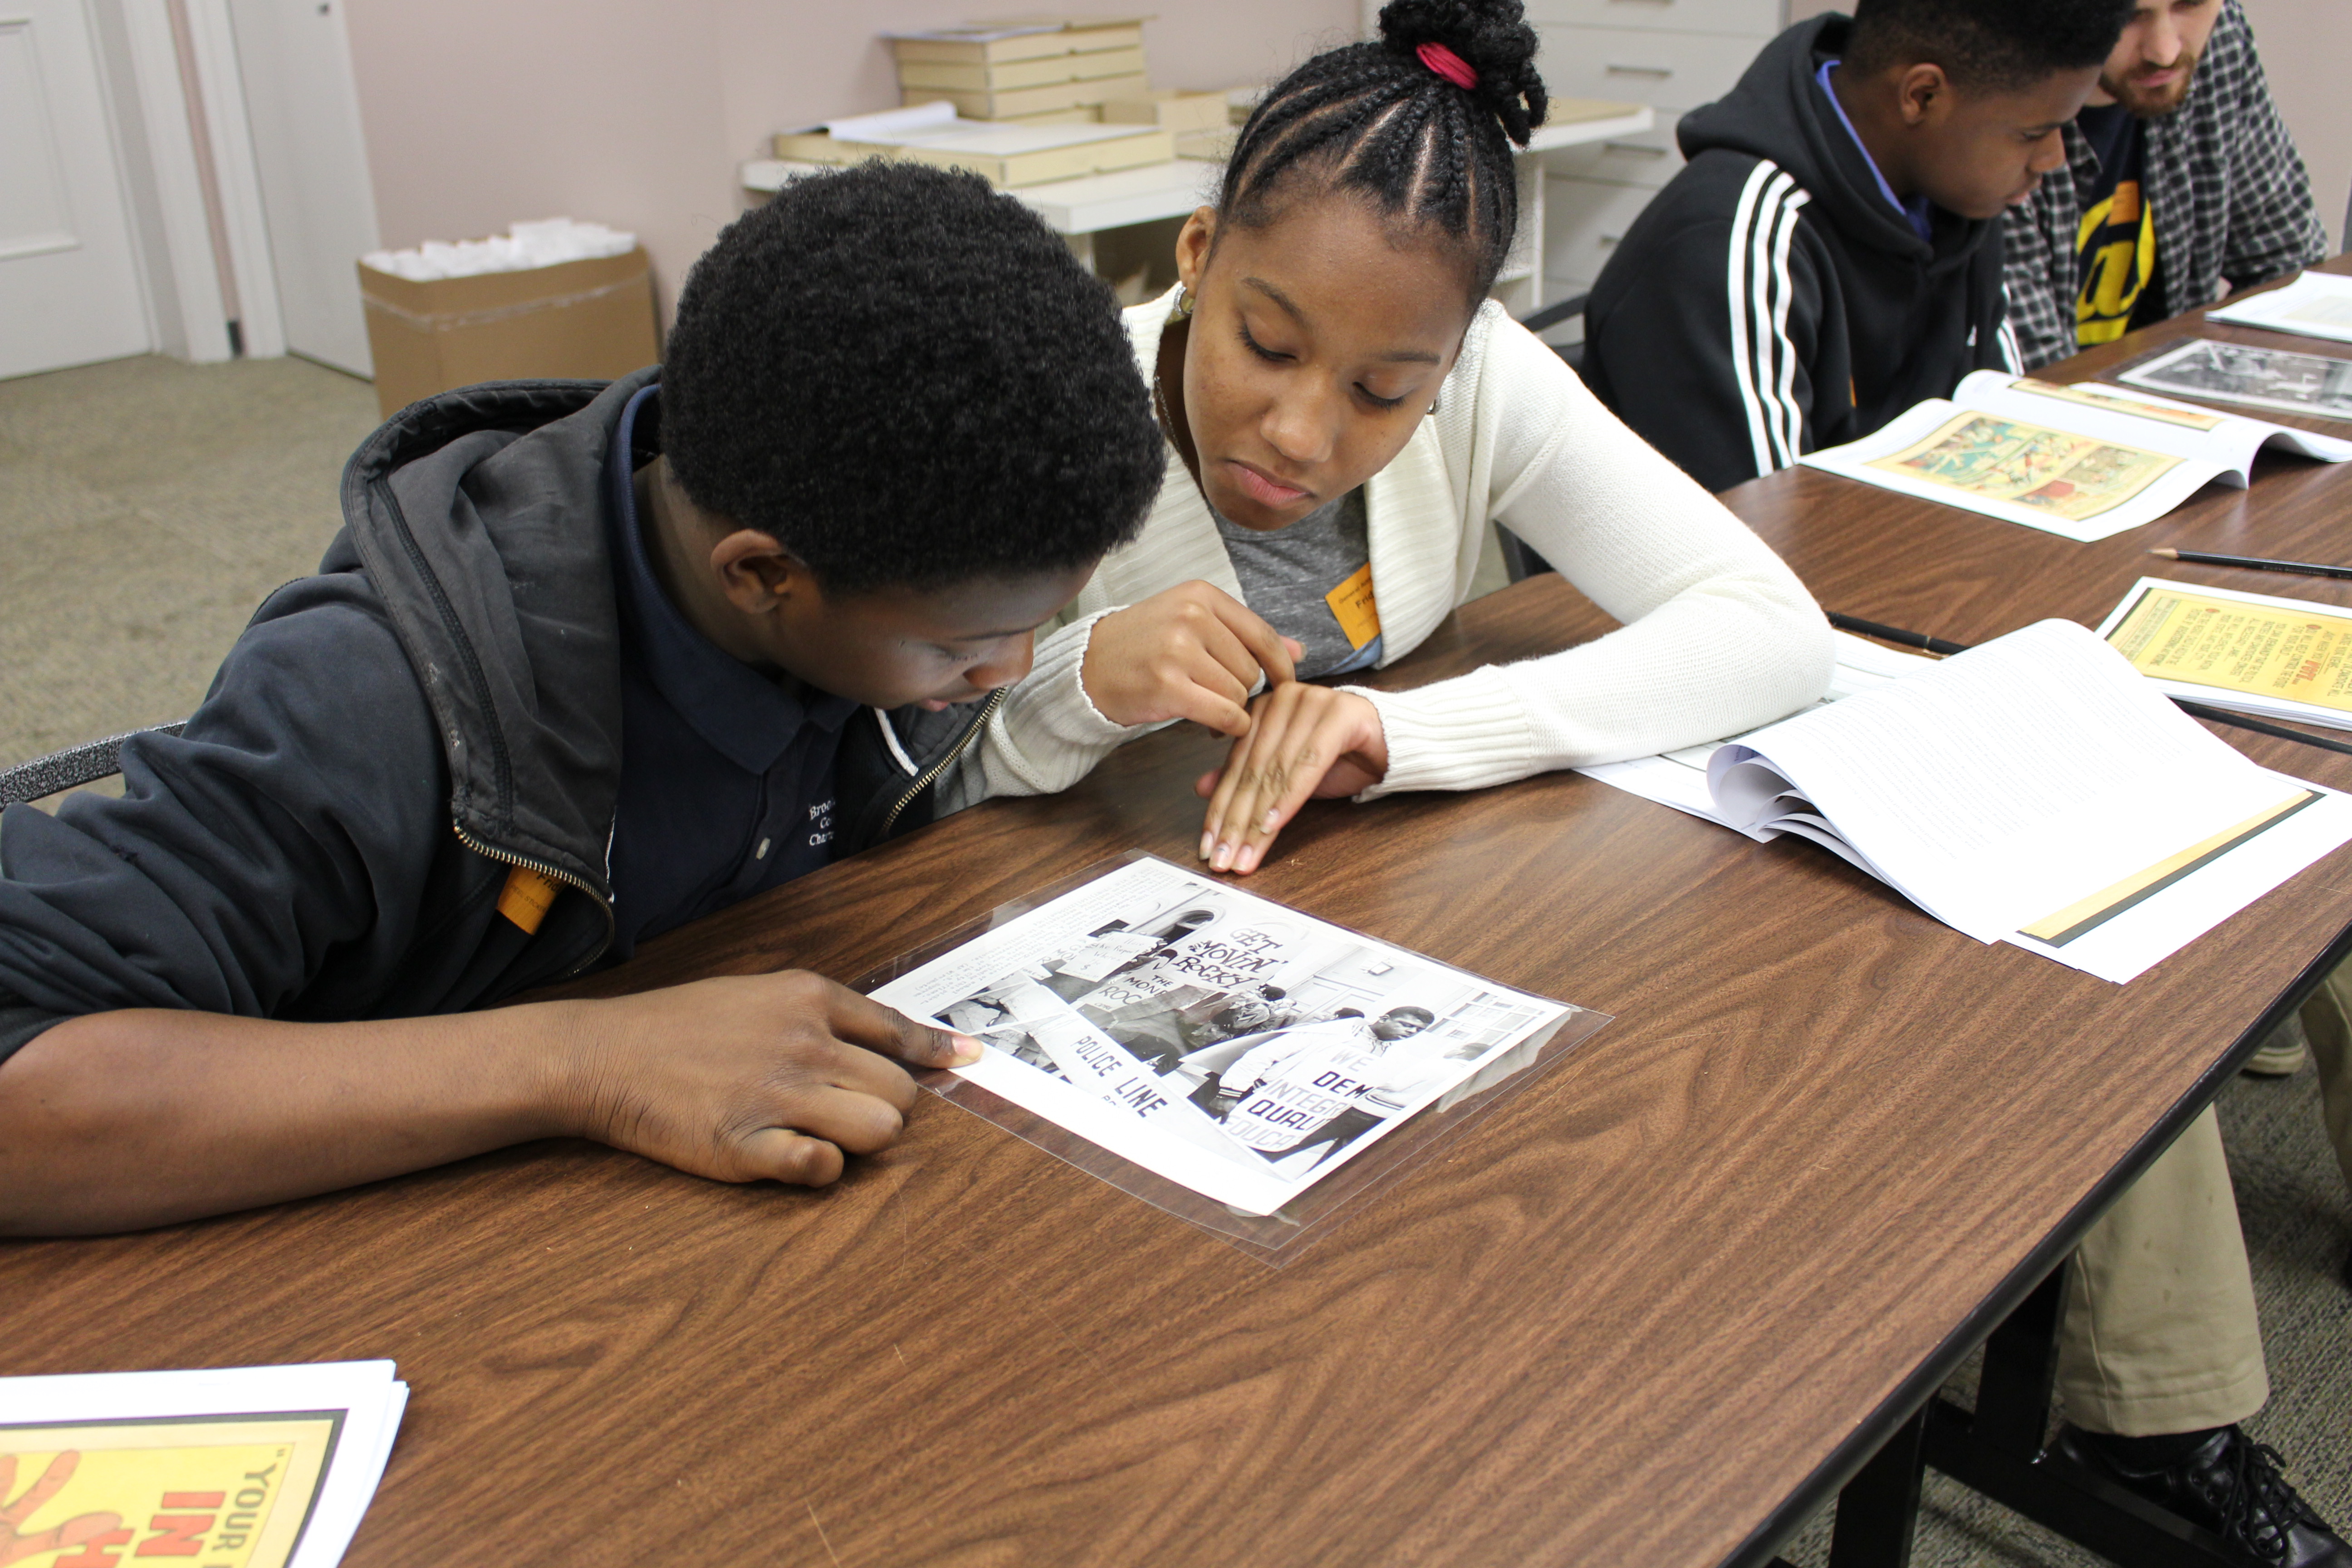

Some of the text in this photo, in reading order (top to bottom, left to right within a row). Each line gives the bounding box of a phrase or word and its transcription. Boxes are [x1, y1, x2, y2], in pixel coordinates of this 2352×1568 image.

[1230, 928, 1283, 955] GET
[1152, 975, 1174, 987] THE
[1329, 1049, 1375, 1072] WE
[1070, 1035, 1169, 1118] POLICE LINE
[133, 1491, 226, 1558] IN
